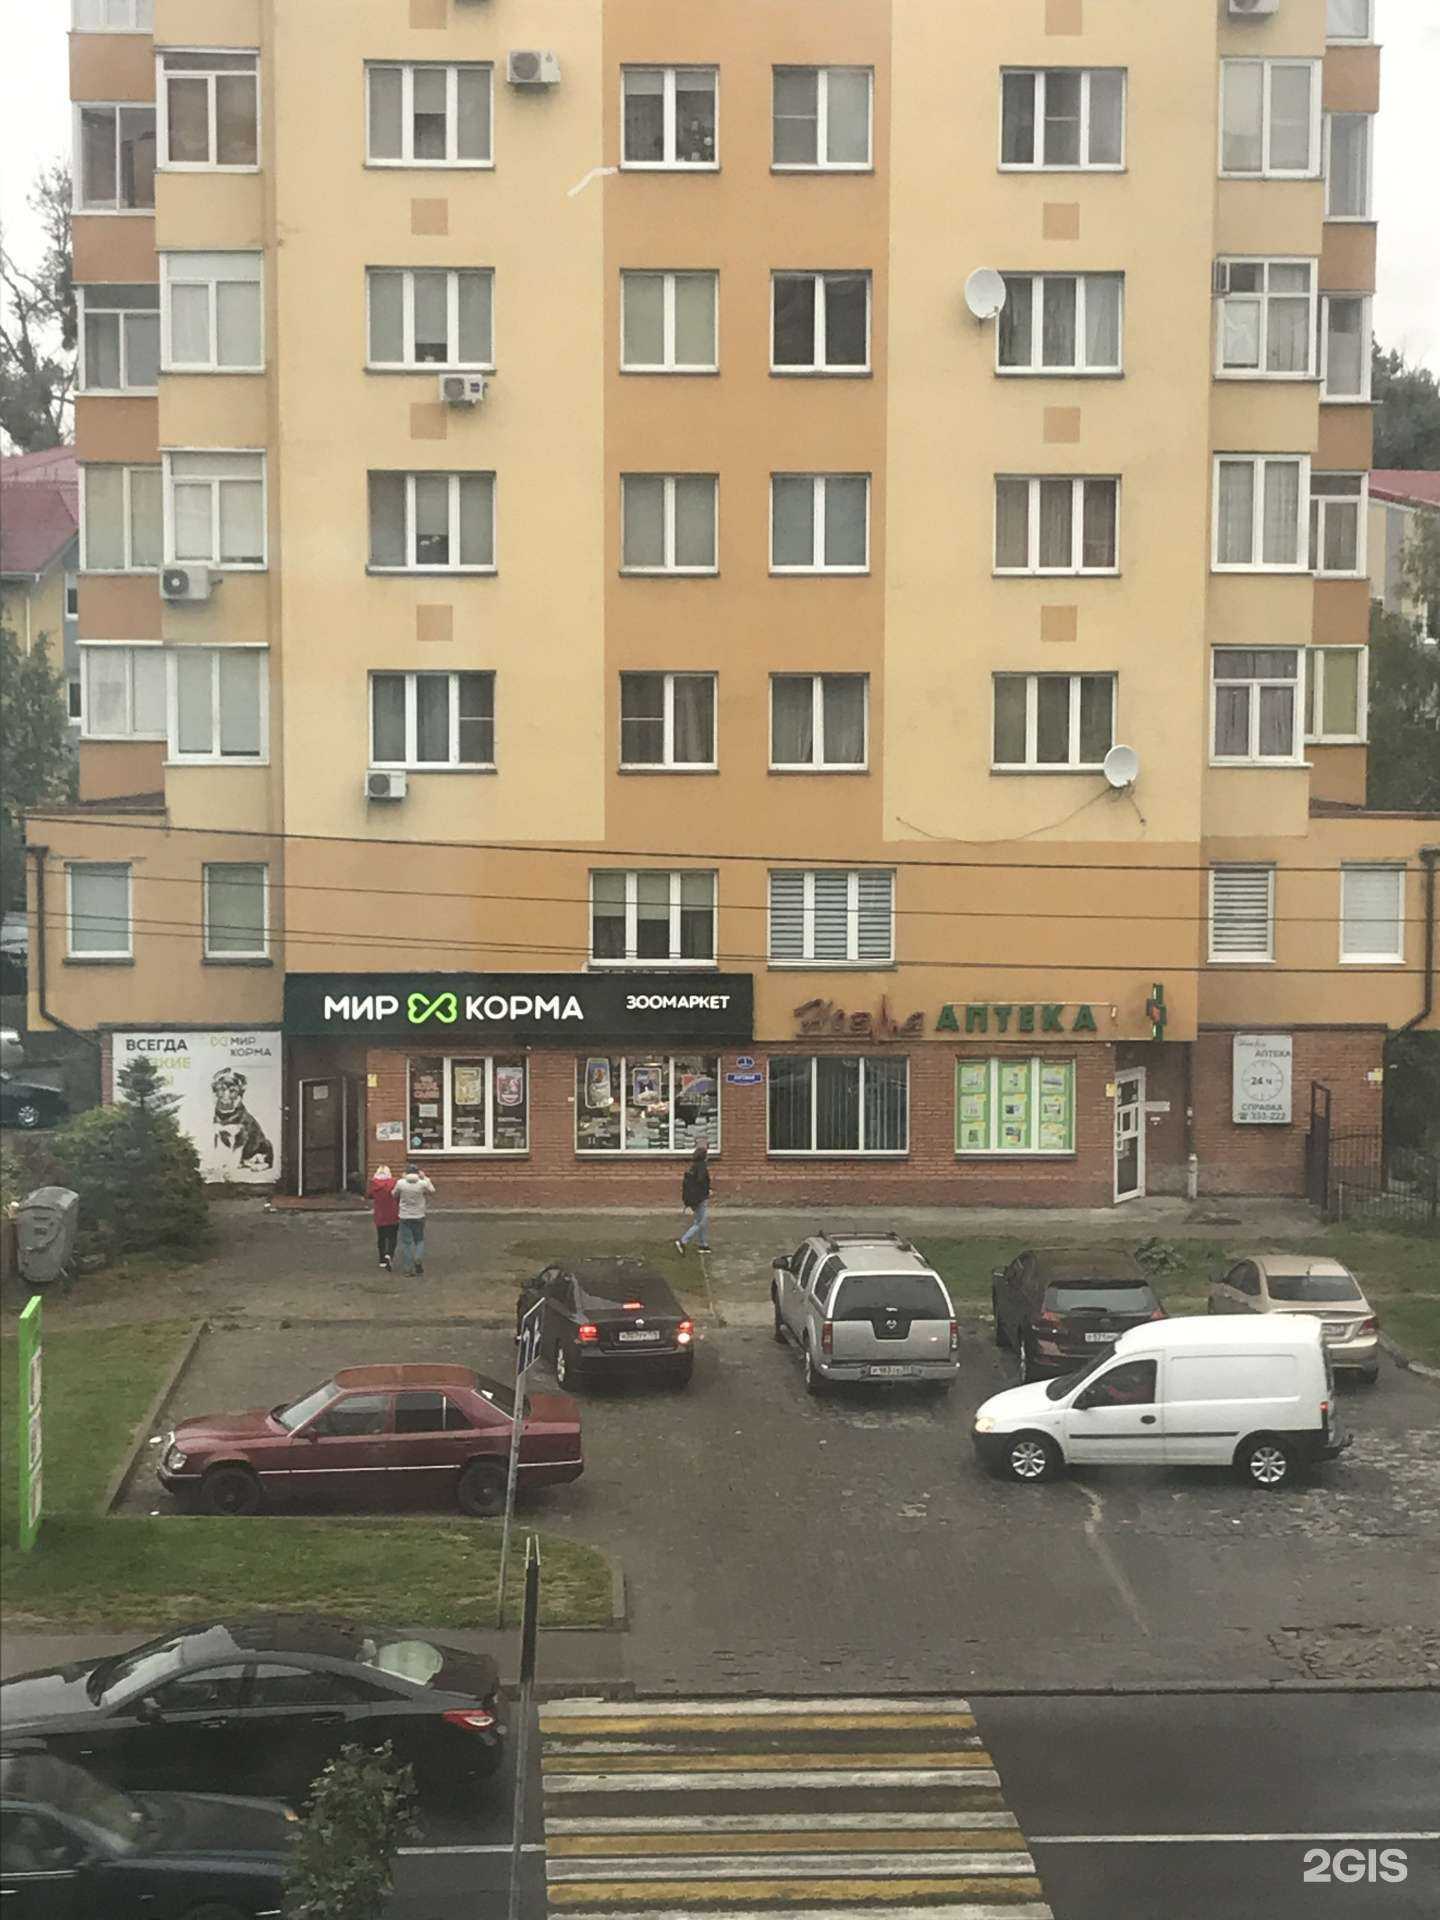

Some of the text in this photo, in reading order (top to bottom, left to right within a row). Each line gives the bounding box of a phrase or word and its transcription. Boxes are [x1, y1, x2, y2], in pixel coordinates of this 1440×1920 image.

[324, 995, 584, 1020] МИР КОРМА
[626, 994, 730, 1010] ЗООМАРКЕТ
[935, 1004, 1097, 1032] АПТЕКА
[126, 1038, 188, 1052] ВСЕГДА
[230, 1036, 256, 1046] МИР
[230, 1048, 271, 1057] КОРМА
